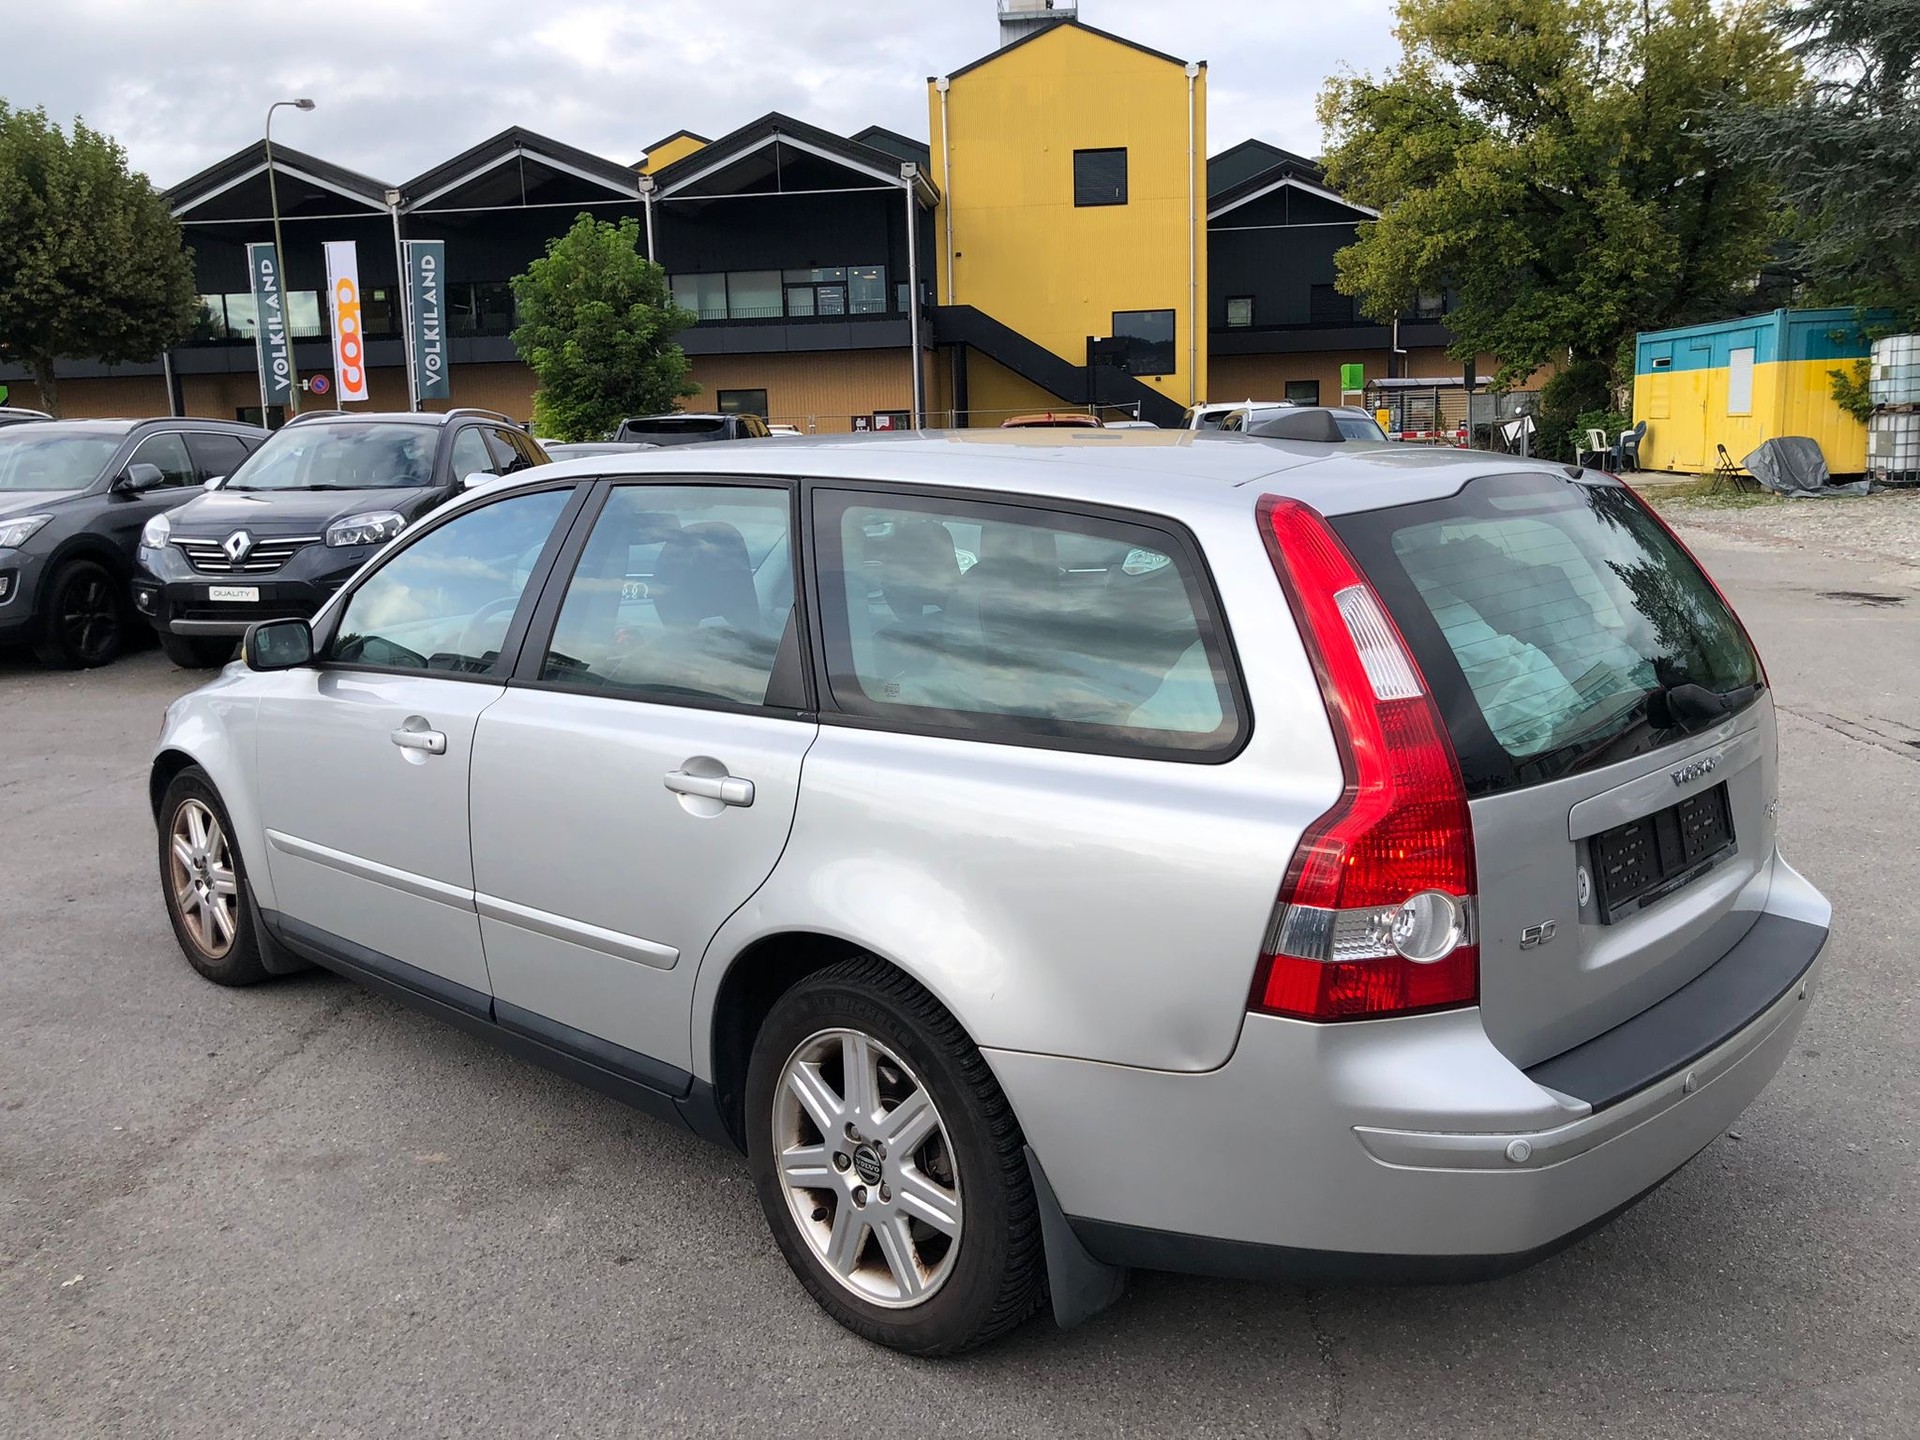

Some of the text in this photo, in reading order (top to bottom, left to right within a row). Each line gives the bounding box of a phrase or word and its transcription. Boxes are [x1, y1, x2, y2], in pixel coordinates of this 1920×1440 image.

[261, 259, 291, 391] VOLKILAND
[421, 255, 442, 387] VOLKILAND
[855, 1157, 880, 1173] VOLVO
